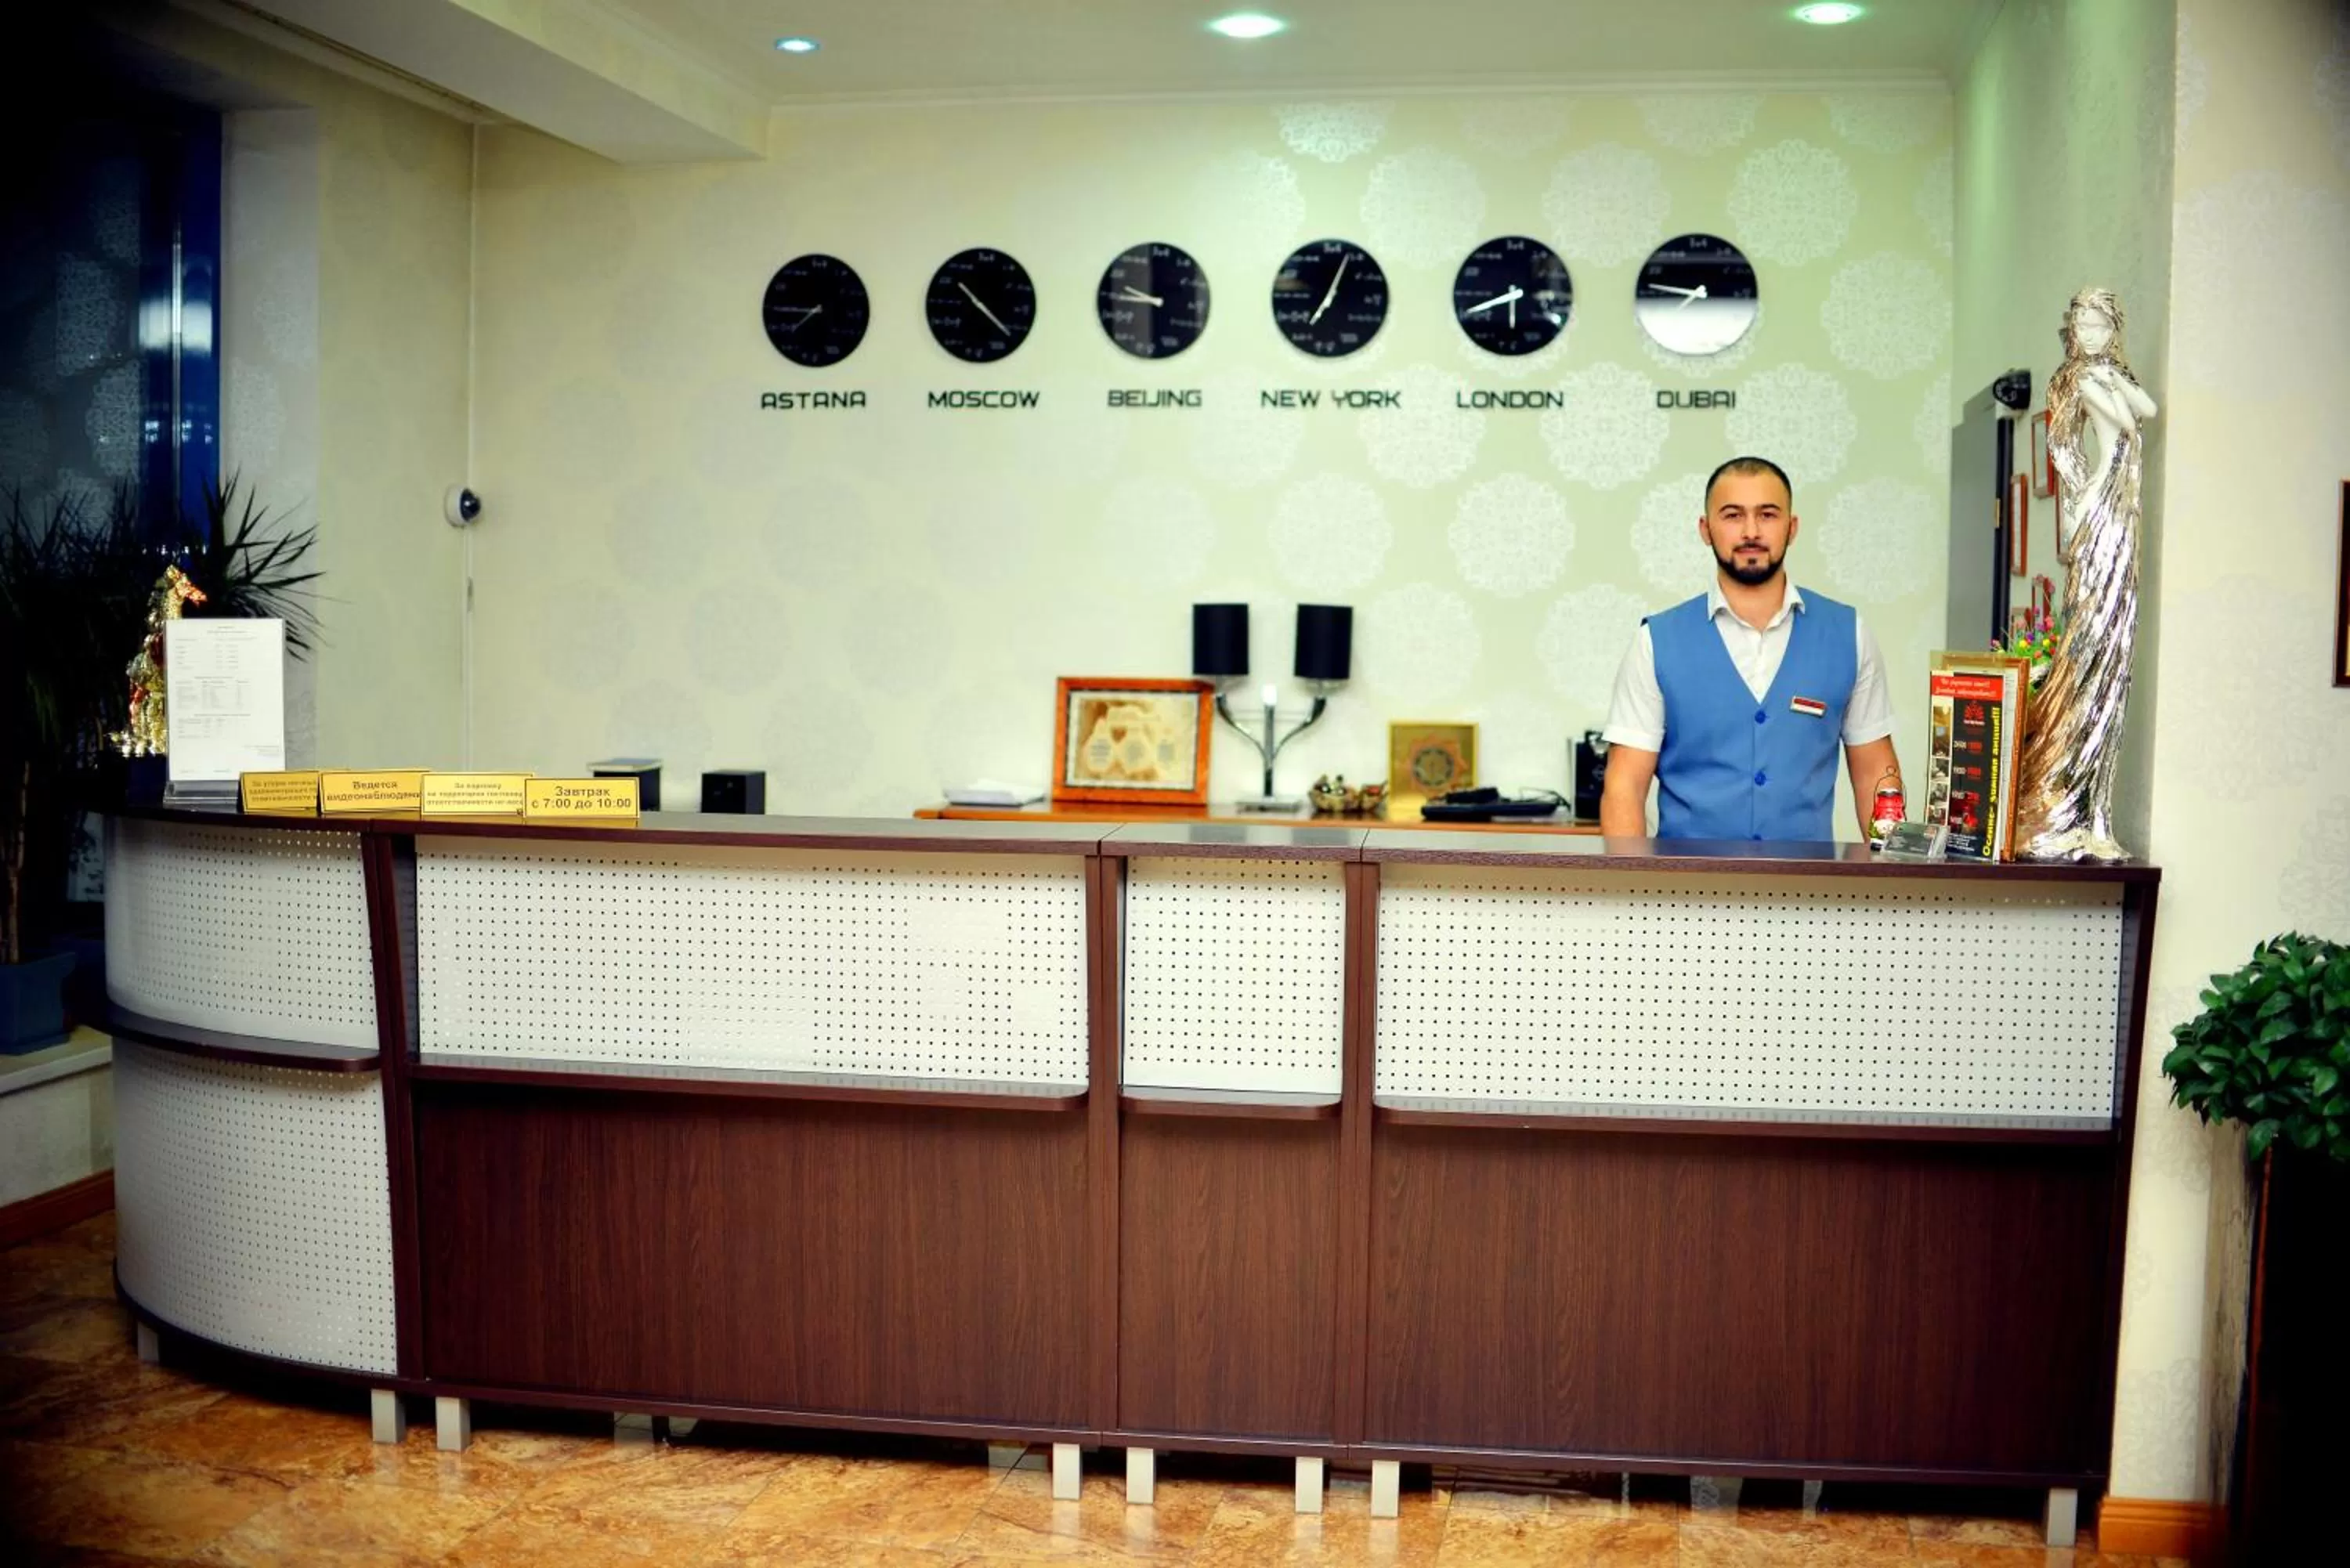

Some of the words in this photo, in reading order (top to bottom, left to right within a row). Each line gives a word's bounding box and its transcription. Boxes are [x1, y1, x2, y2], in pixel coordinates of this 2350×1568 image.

[761, 391, 867, 410] ASTANA
[928, 390, 1040, 409] MOSCOW
[1107, 389, 1202, 408] BEIJING
[1261, 390, 1319, 408] NEW
[1332, 390, 1401, 408] YORK
[1456, 390, 1564, 409] LONDON
[1656, 390, 1737, 409] DUBAI
[326, 790, 422, 802] видеонаблюдени
[554, 786, 611, 798] Завтрак
[531, 800, 540, 809] с
[543, 798, 572, 808] 7:00
[574, 800, 593, 810] до
[596, 798, 631, 808] 10:00
